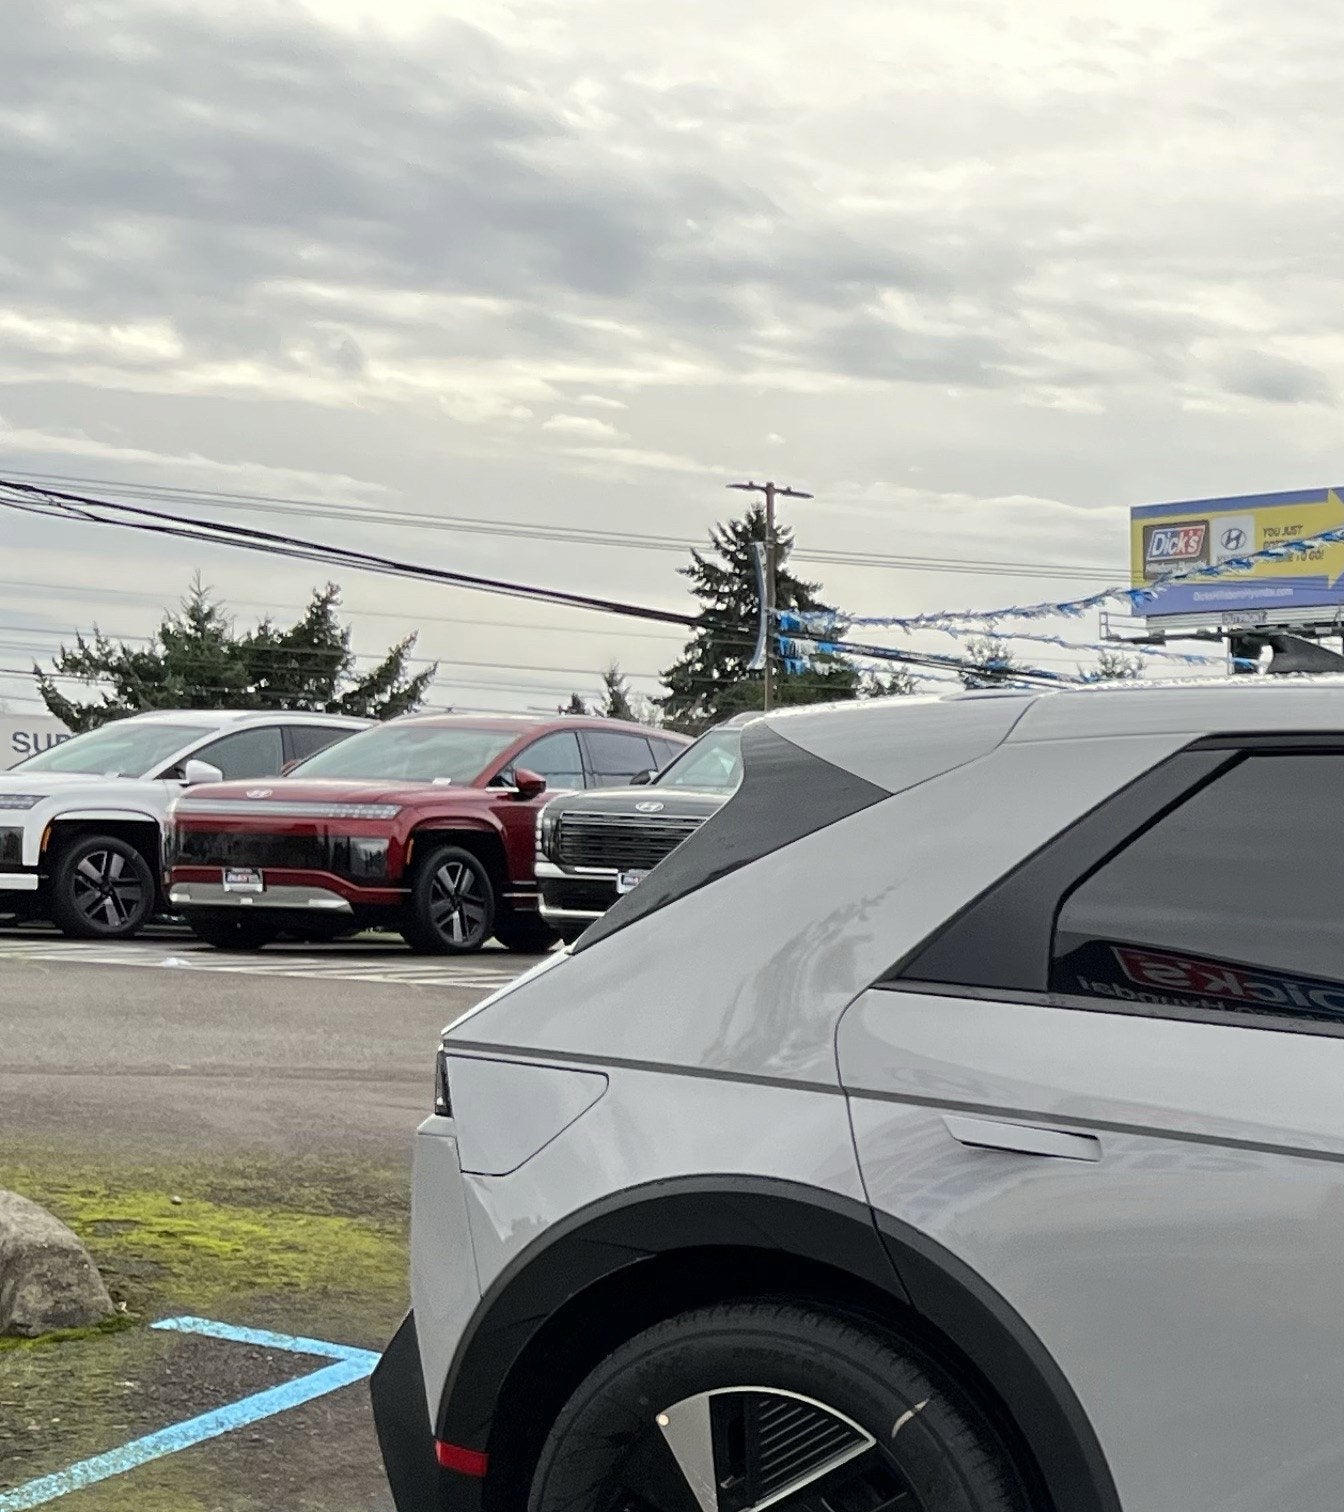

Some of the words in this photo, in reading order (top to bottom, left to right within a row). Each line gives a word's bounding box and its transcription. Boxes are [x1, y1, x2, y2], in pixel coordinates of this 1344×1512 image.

[1263, 526, 1281, 537] YOU
[1282, 524, 1304, 535] JUST
[1309, 549, 1325, 561] GO!
